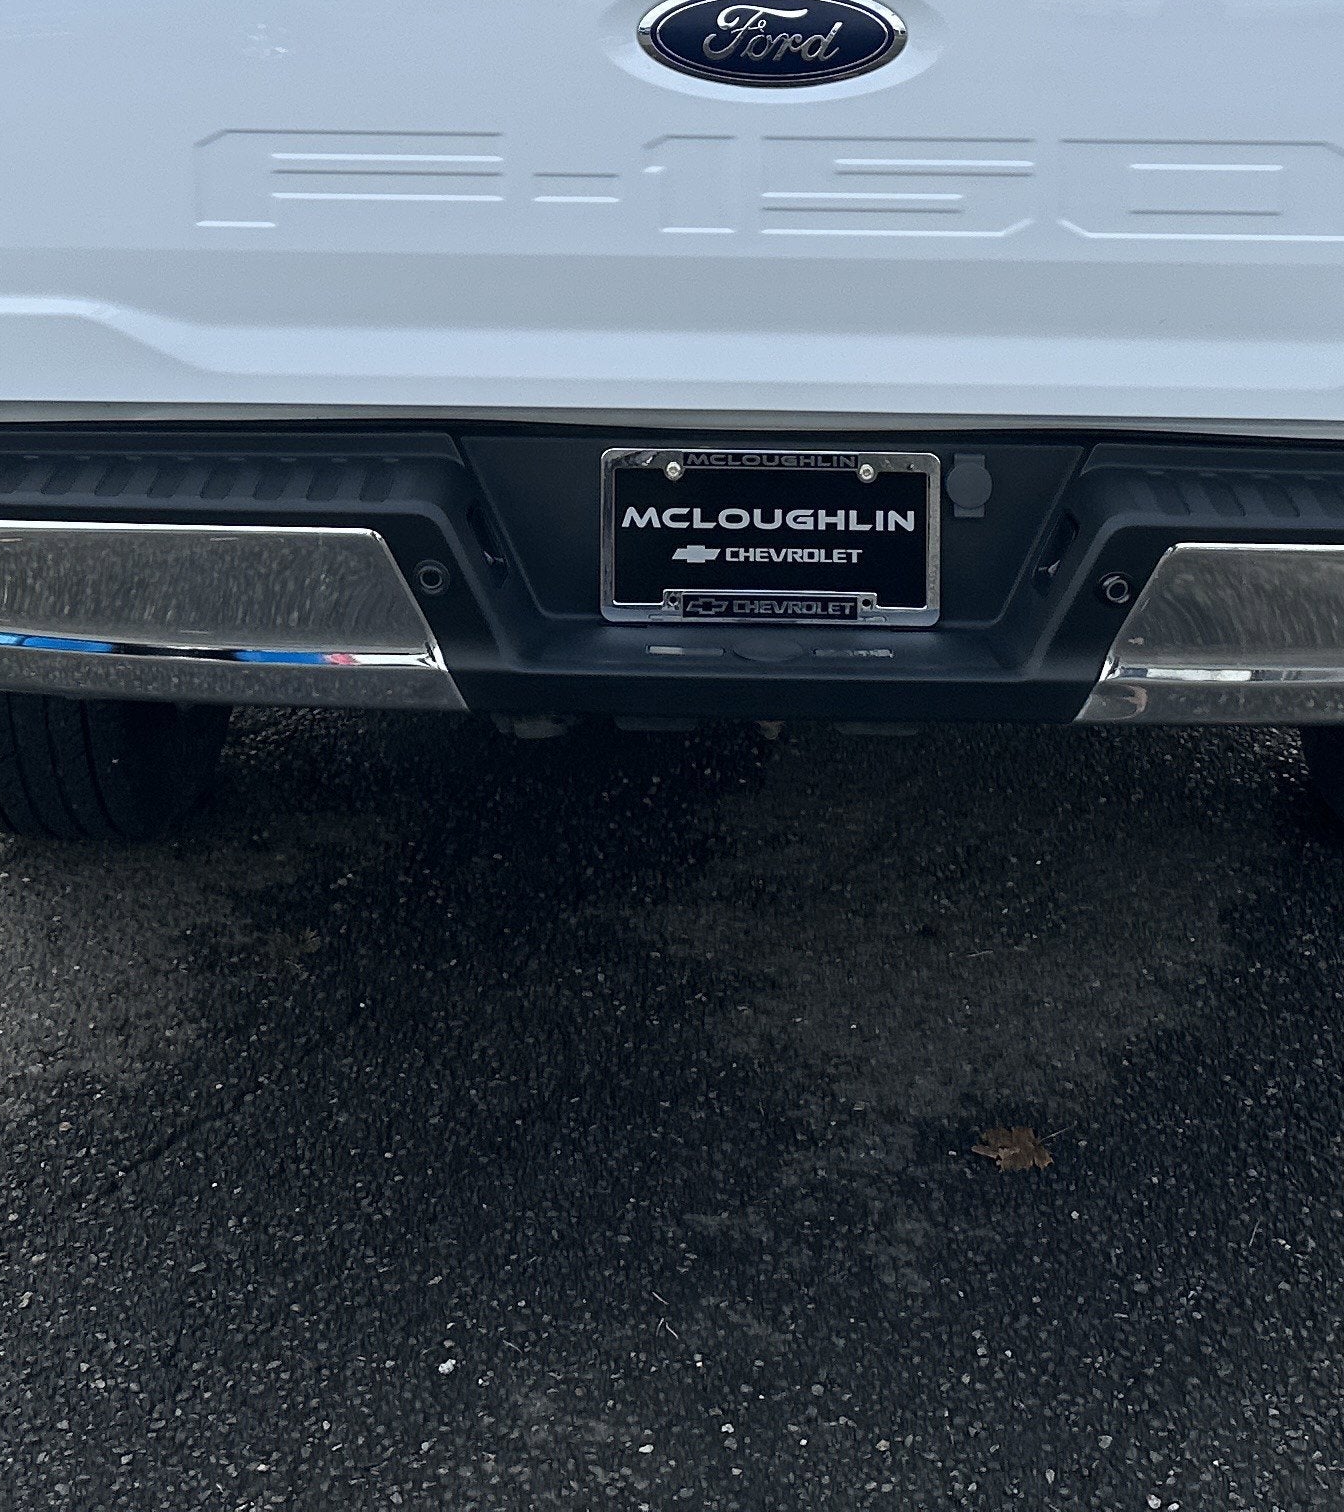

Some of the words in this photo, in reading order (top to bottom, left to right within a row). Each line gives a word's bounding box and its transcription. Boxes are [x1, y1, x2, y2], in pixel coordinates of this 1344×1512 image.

[702, 4, 843, 62] Ford
[686, 452, 857, 468] MCLOUGHLIN
[621, 506, 915, 532] MCLOUGHLIN
[725, 547, 863, 564] CHEVROLET
[732, 599, 855, 616] CHEVROLET
